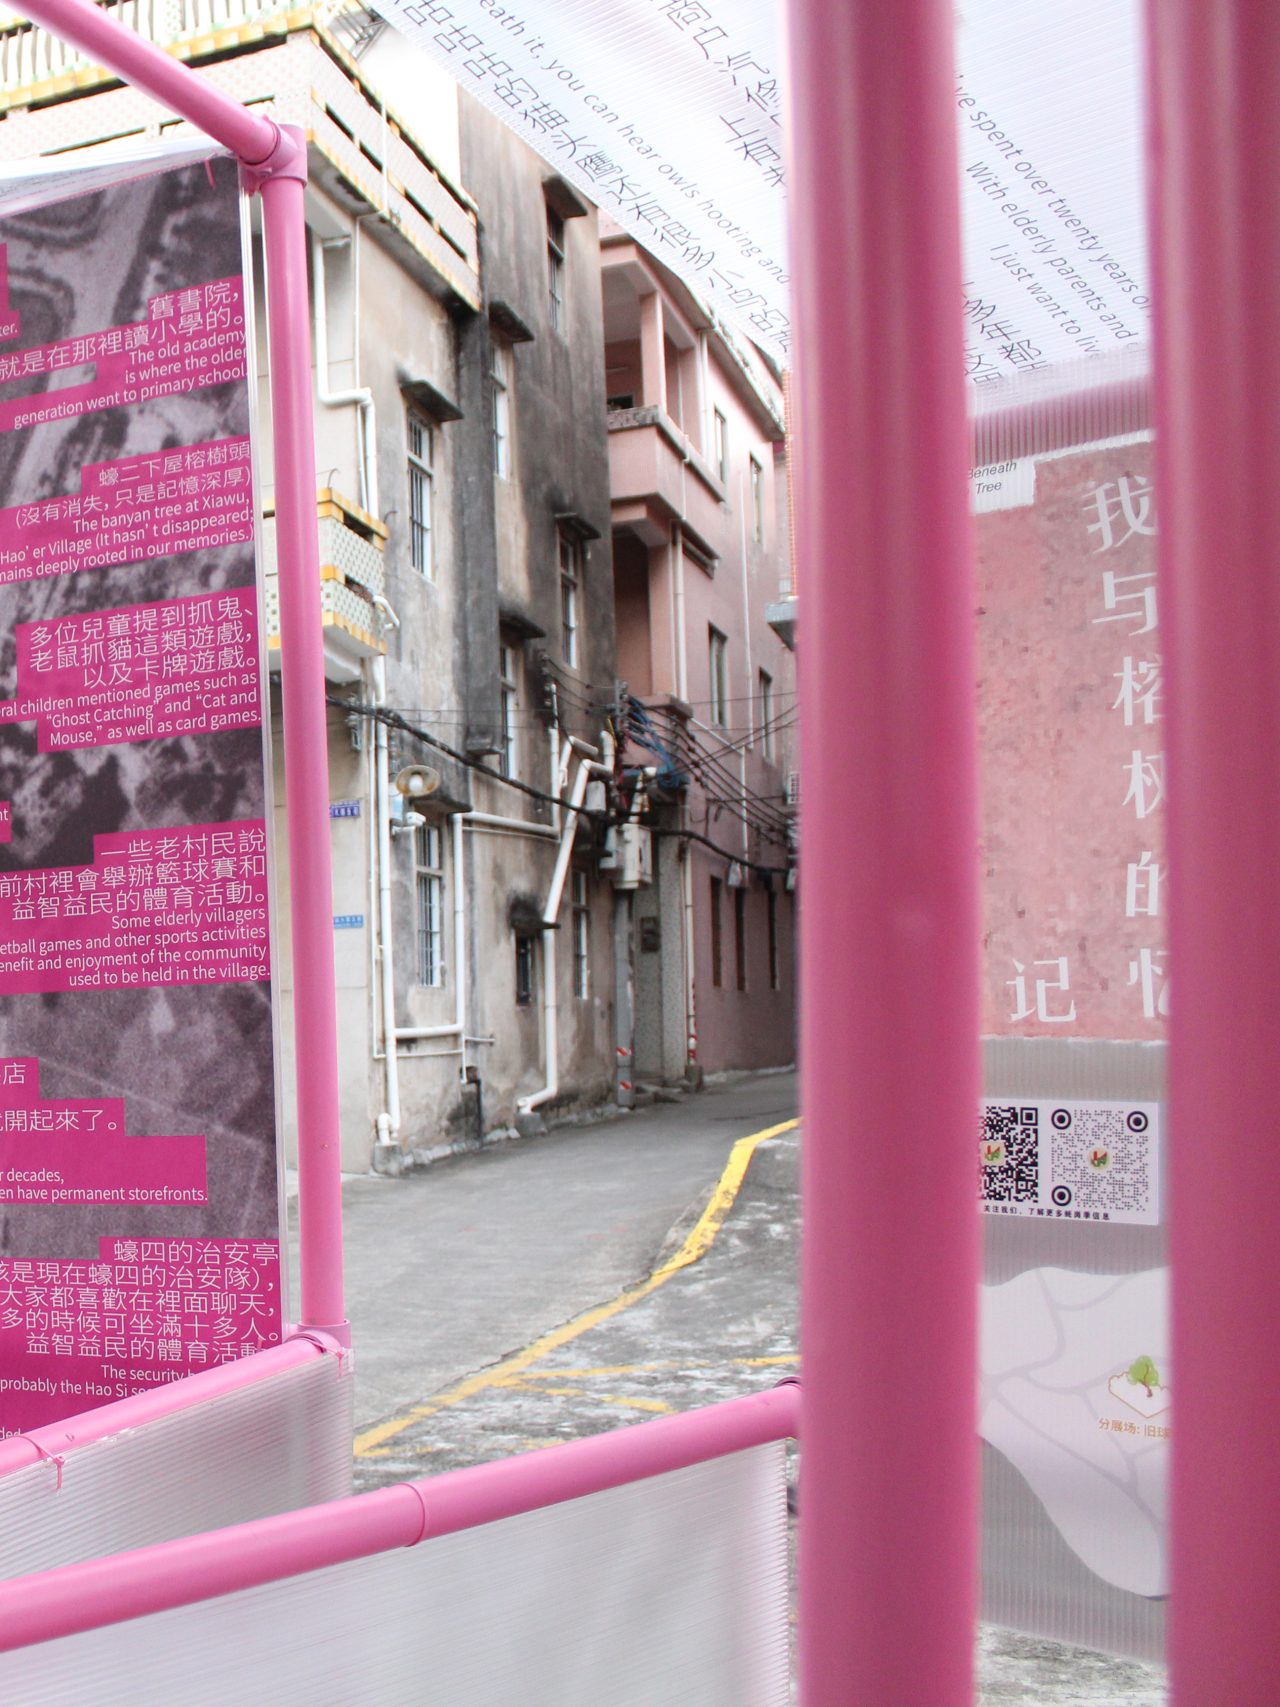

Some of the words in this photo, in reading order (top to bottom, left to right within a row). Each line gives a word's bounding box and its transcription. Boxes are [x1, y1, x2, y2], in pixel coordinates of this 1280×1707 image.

[523, 36, 544, 59] it,
[540, 59, 585, 92] you
[584, 94, 619, 124] can
[616, 123, 662, 160] hear
[658, 163, 700, 199] owls
[696, 198, 763, 257] hooting
[970, 111, 1023, 160] spent
[1014, 161, 1056, 196] over
[1048, 198, 1104, 251] twenty
[1088, 253, 1139, 293] years
[966, 161, 1008, 200] With
[1001, 203, 1057, 254] elderly
[1043, 256, 1107, 312] parents
[1099, 312, 1139, 340] and
[990, 252, 1035, 282] just
[1026, 282, 1070, 319] want
[1060, 318, 1081, 336] to
[125, 370, 135, 383] is
[138, 364, 181, 380] where
[184, 357, 207, 372] the
[211, 351, 250, 366] older
[129, 350, 154, 364] The
[157, 343, 179, 359] old
[183, 333, 249, 353] academy
[14, 401, 83, 426] generation
[86, 392, 119, 408] went
[122, 390, 136, 402] to
[140, 380, 194, 401] primary
[975, 481, 1002, 495] Tree
[73, 519, 97, 533] The
[101, 512, 150, 528] banyan
[154, 507, 181, 520] tree
[185, 502, 199, 514] at
[202, 496, 252, 511] Xiawu,
[35, 558, 79, 576] deeply
[83, 549, 126, 568] rooted
[131, 547, 143, 560] in
[146, 545, 170, 557] our
[174, 526, 255, 552] memories.)
[30, 596, 253, 651] 多位兒童提到抓鬼、
[30, 620, 252, 673] 老鼠抓貓這類遊戲，
[83, 645, 257, 689] 以及卡牌遊戲。
[20, 698, 73, 714] children
[77, 685, 150, 706] mentioned
[154, 682, 200, 699] games
[203, 674, 236, 690] such
[241, 674, 260, 685] as
[50, 727, 101, 745] Mouse,”
[107, 728, 122, 739] as
[125, 721, 153, 736] well
[157, 722, 172, 733] as
[175, 715, 206, 730] card
[210, 712, 262, 729] games.
[100, 828, 265, 863] 一些老村民說
[11, 880, 265, 921] 益智益民的體育活動。
[111, 916, 150, 929] Some
[153, 911, 202, 927] elderly
[204, 909, 265, 924] villagers
[37, 956, 61, 970] and
[65, 954, 137, 971] enjoyment
[141, 951, 154, 965] of
[157, 950, 180, 964] the
[184, 946, 266, 962] community
[6, 1169, 64, 1184] decades,
[113, 1239, 278, 1267] 蠔四的治安亭
[0, 1285, 275, 1317] 大家都喜歡在裡面聊天，
[102, 1365, 126, 1379] The
